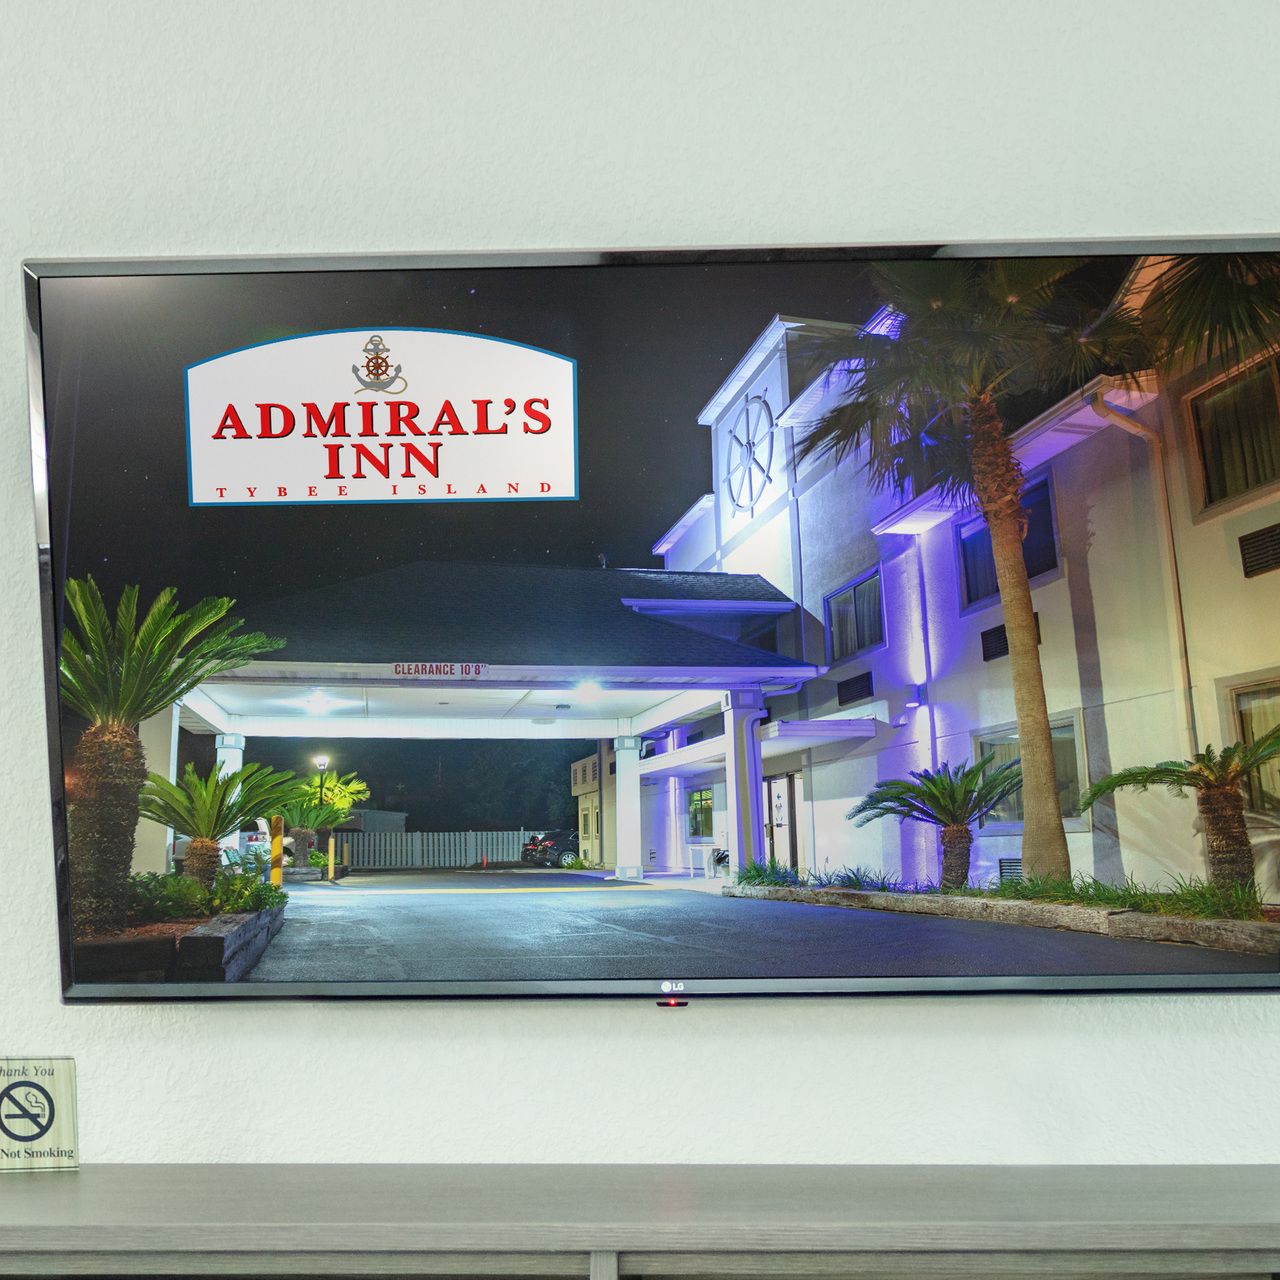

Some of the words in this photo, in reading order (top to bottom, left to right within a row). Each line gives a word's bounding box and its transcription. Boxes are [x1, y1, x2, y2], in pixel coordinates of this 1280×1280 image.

[211, 397, 552, 439] ADMIRAL'S
[324, 441, 443, 480] INN
[216, 485, 348, 498] TYBEE
[391, 482, 551, 496] ISLAND
[394, 663, 456, 676] CLEARANCE
[672, 982, 685, 991] LG
[33, 1066, 55, 1077] You
[0, 1148, 21, 1159] Not
[23, 1147, 74, 1159] Smoking
